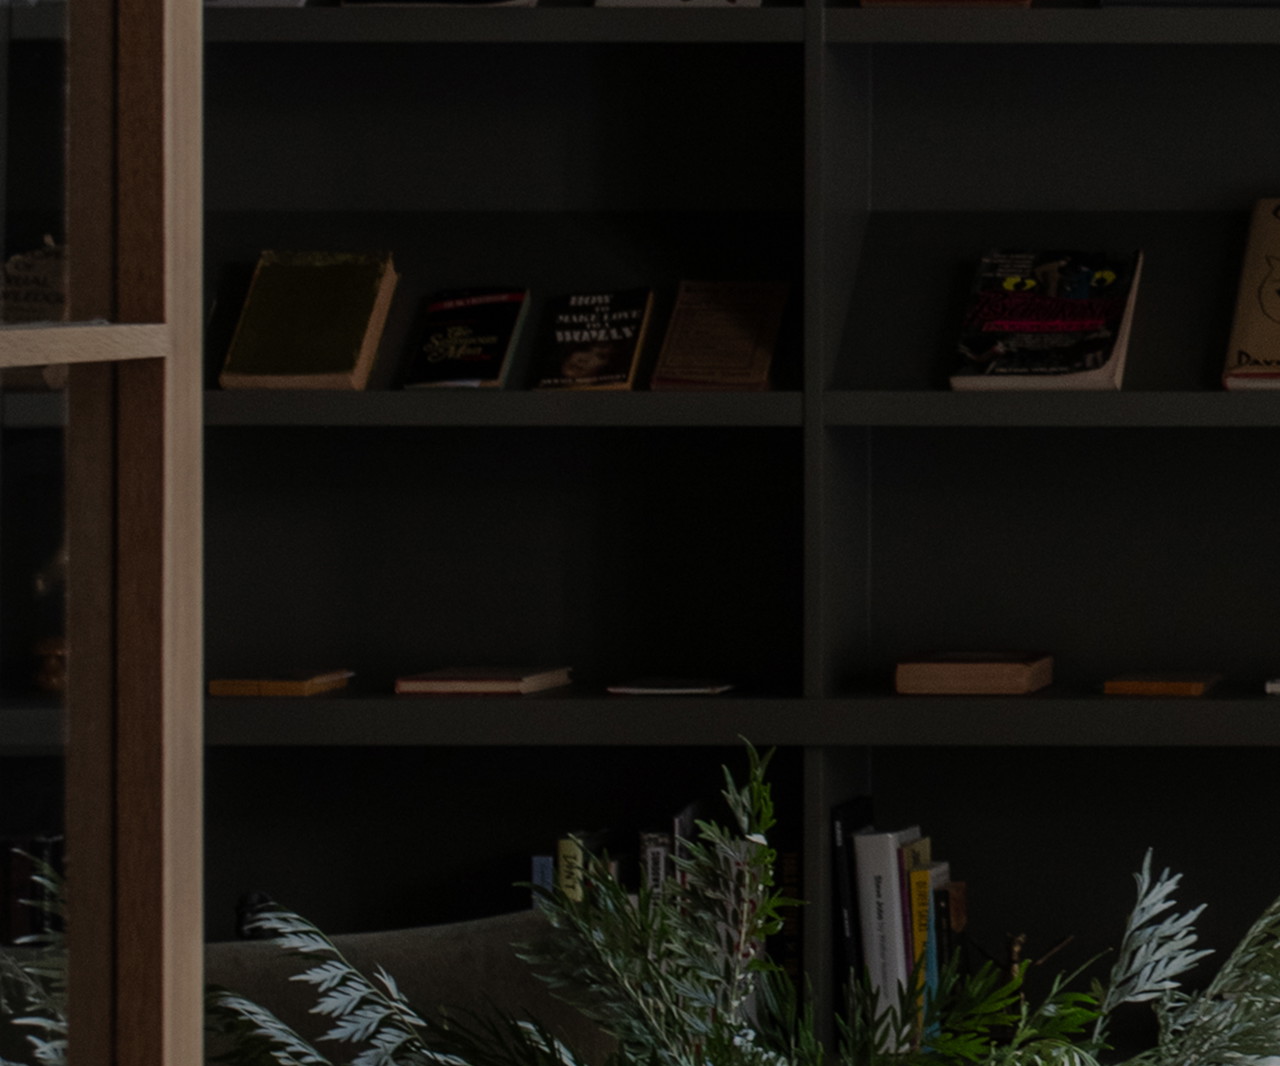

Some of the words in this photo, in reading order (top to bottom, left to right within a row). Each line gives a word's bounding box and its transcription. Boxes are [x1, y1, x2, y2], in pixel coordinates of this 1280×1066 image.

[569, 294, 614, 307] HOW
[556, 314, 597, 324] MAKE
[603, 309, 642, 321] LOVE
[872, 874, 884, 899] Steve
[874, 900, 885, 922] Jobs
